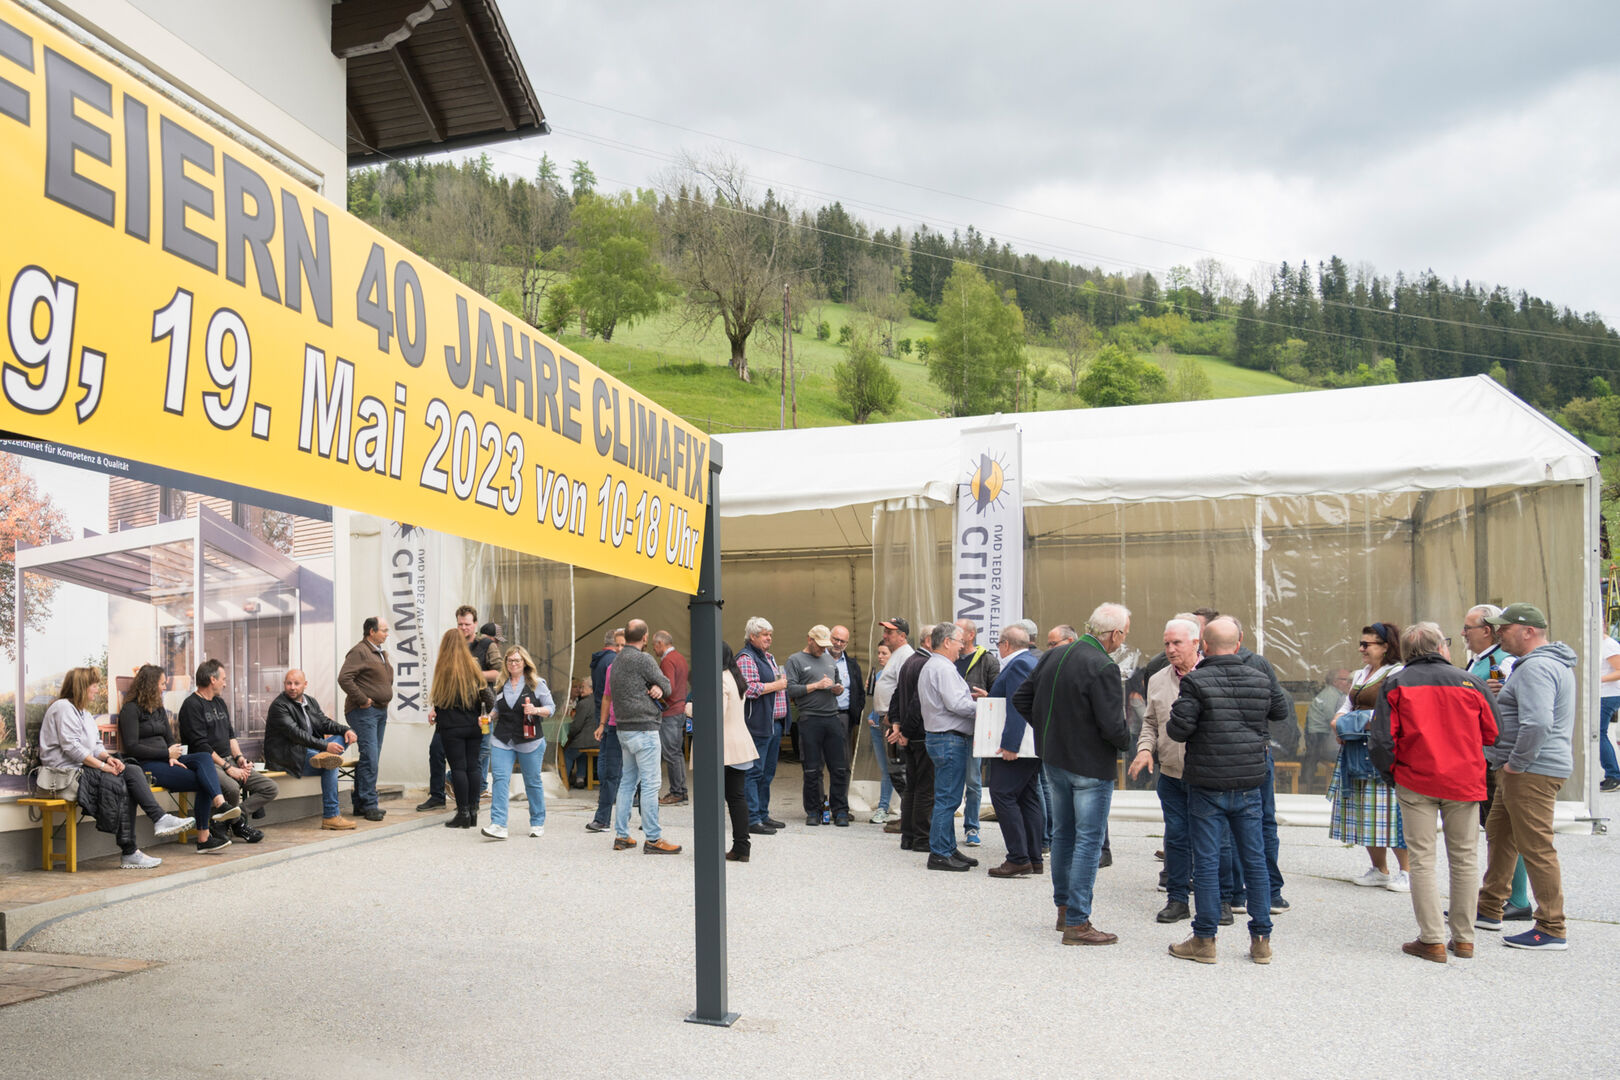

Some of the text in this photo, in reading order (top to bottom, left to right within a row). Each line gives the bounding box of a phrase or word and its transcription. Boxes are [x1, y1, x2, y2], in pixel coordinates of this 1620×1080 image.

[45, 443, 56, 454] für
[57, 447, 95, 463] Kompetenz
[96, 456, 102, 465] &
[103, 458, 129, 471] Qualität
[151, 287, 272, 441] 19.
[298, 342, 407, 480] Mai
[420, 397, 525, 515] 2023
[535, 464, 588, 537] von
[597, 474, 662, 560] 10-18
[664, 502, 700, 571] Uhr
[356, 241, 427, 368] 40
[444, 293, 583, 444] JAHRE
[592, 376, 706, 504] CLIMAFIX
